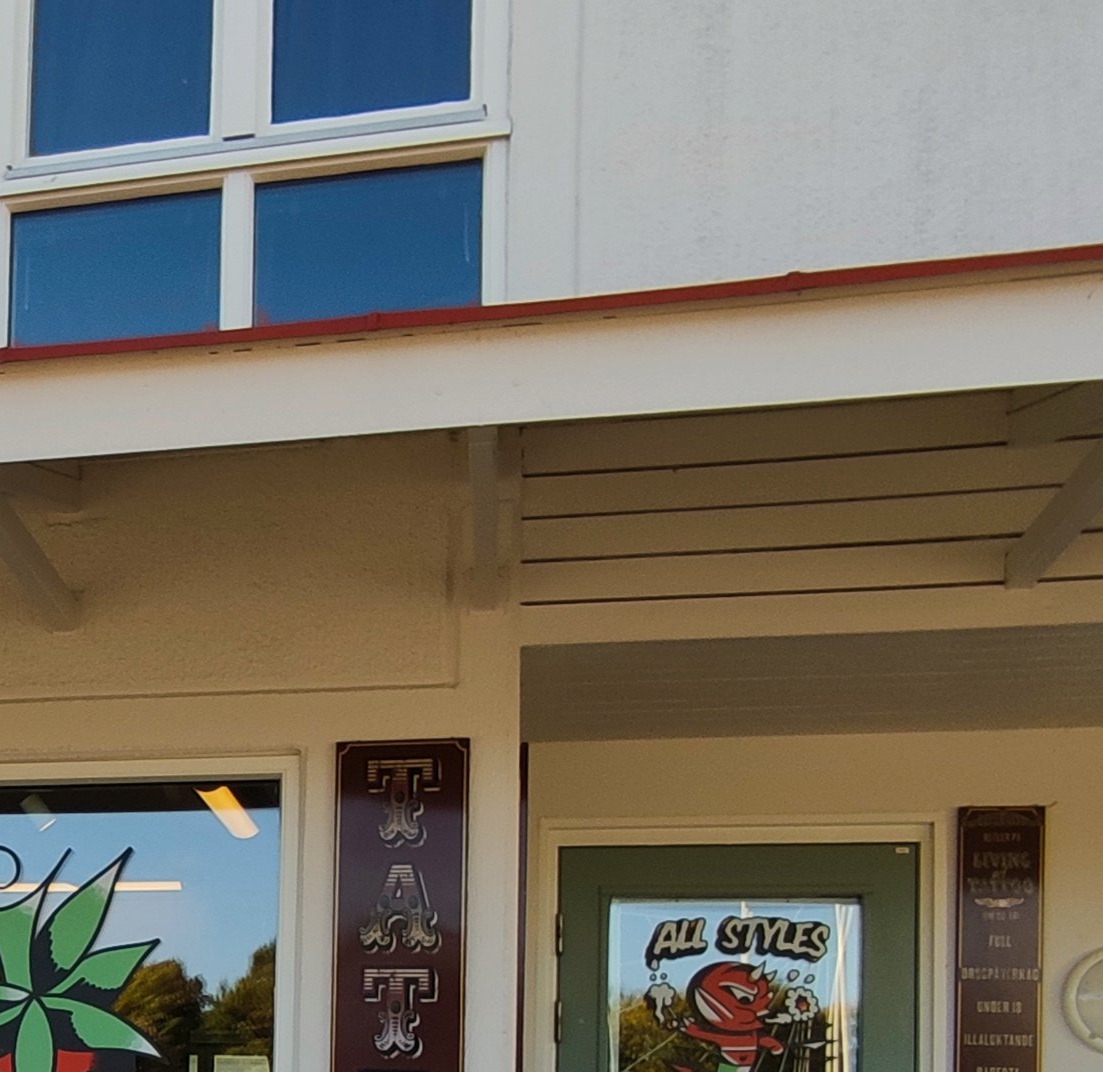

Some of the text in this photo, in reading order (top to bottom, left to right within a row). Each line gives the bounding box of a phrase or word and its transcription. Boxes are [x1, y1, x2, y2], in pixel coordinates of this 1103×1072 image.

[650, 917, 830, 959] ALL STYLES
[976, 1001, 1010, 1013] UNDER
[963, 1033, 1034, 1047] ILLALUKTANDE
